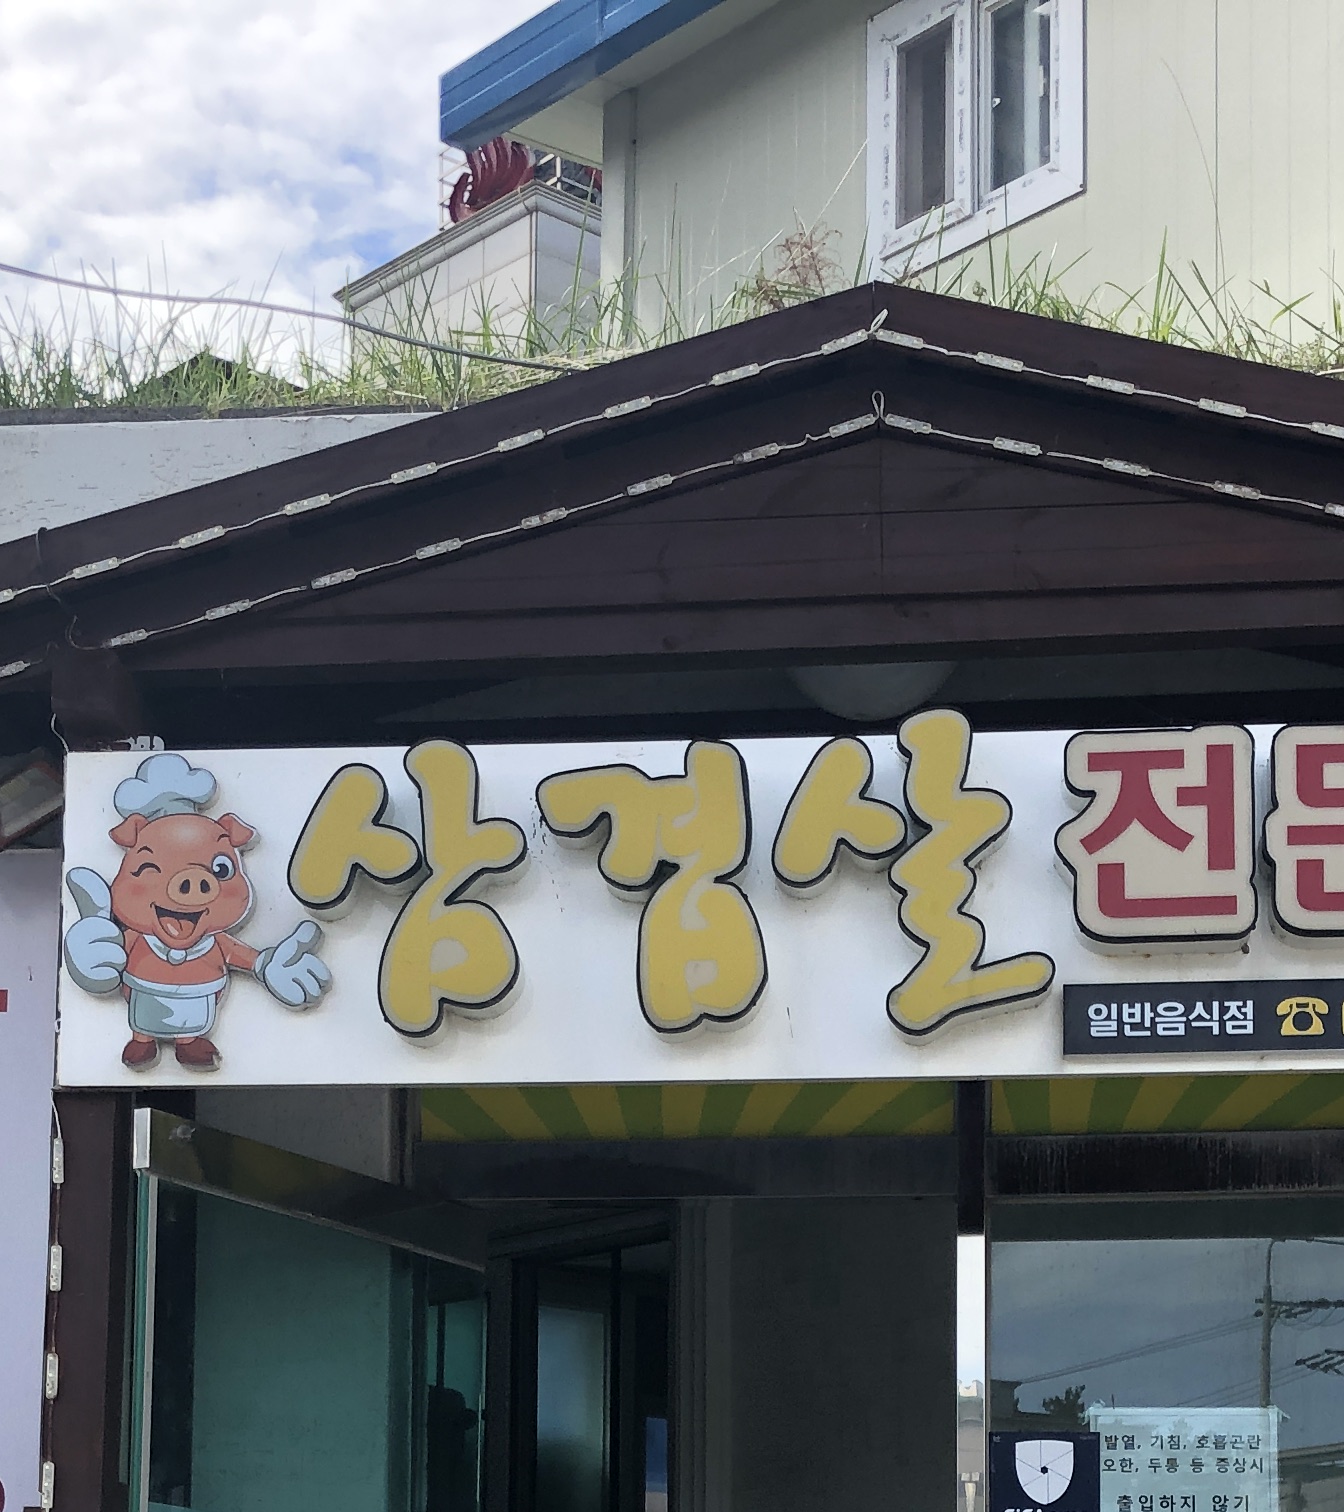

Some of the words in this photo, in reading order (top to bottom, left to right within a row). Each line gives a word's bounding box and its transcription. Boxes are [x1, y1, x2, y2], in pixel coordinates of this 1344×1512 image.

[287, 706, 1056, 1044] 삼겹살
[1087, 999, 1255, 1038] 일반음식점
[1150, 1434, 1187, 1450] 기침,
[1195, 1434, 1262, 1450] 호흡곤란
[1102, 1457, 1139, 1473] 오한,
[1148, 1457, 1180, 1473] 두통
[1190, 1457, 1205, 1473] 등
[1215, 1457, 1264, 1473] 증상시
[1116, 1494, 1196, 1512] 출입하지
[1212, 1494, 1250, 1512] 않기
